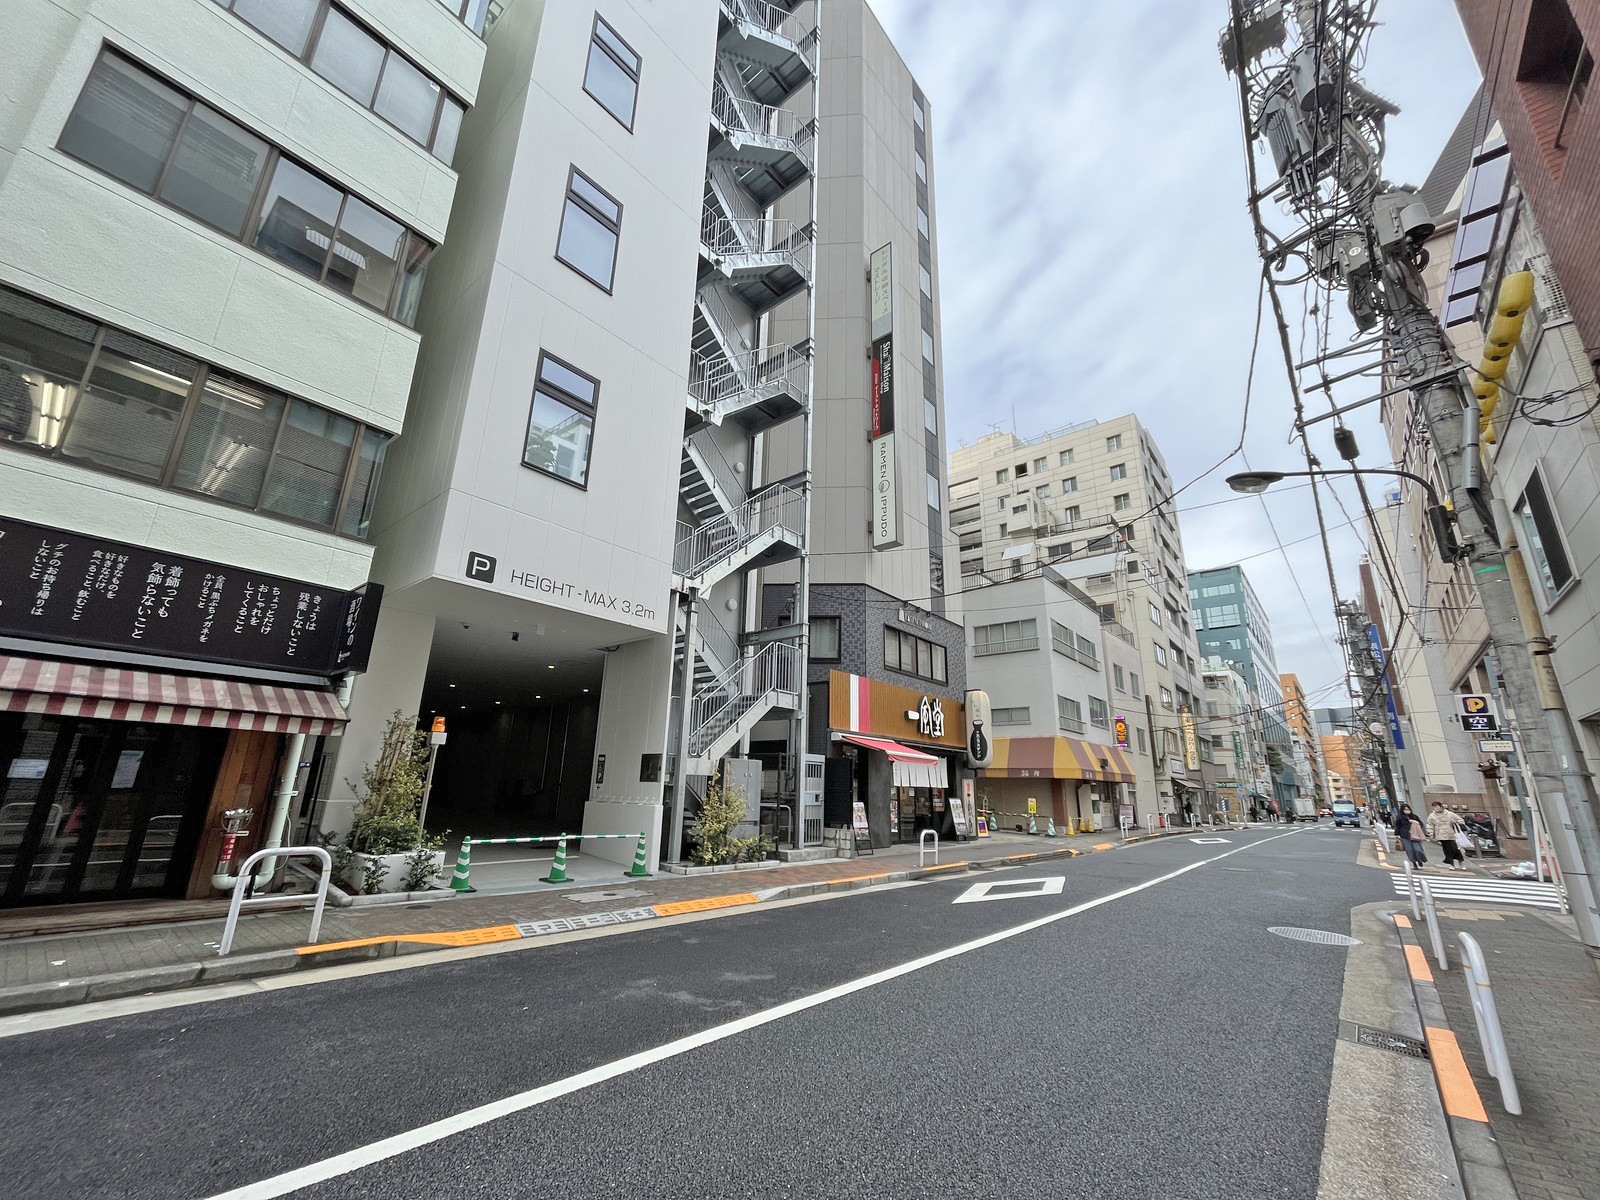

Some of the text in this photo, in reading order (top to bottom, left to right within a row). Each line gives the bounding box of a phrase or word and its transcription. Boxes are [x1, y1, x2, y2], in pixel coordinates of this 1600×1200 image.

[29, 539, 51, 580] しないこと
[31, 543, 69, 616] グチのお持ち帰りは
[106, 554, 129, 599] 好きなものを
[472, 557, 490, 575] P
[131, 562, 166, 639] 気飾らないこと
[158, 565, 184, 618] 着飾っても
[197, 573, 214, 609] かけること
[234, 581, 255, 634] してくること
[250, 583, 269, 626] おしゃれを
[260, 586, 280, 635] ちょっとだけ
[305, 594, 322, 631] きょうは
[621, 600, 655, 620] 3.2m
[286, 592, 311, 656] 残業しないこと
[908, 695, 945, 738] 一風堂
[1466, 698, 1484, 712] P
[1469, 716, 1490, 730] 空
